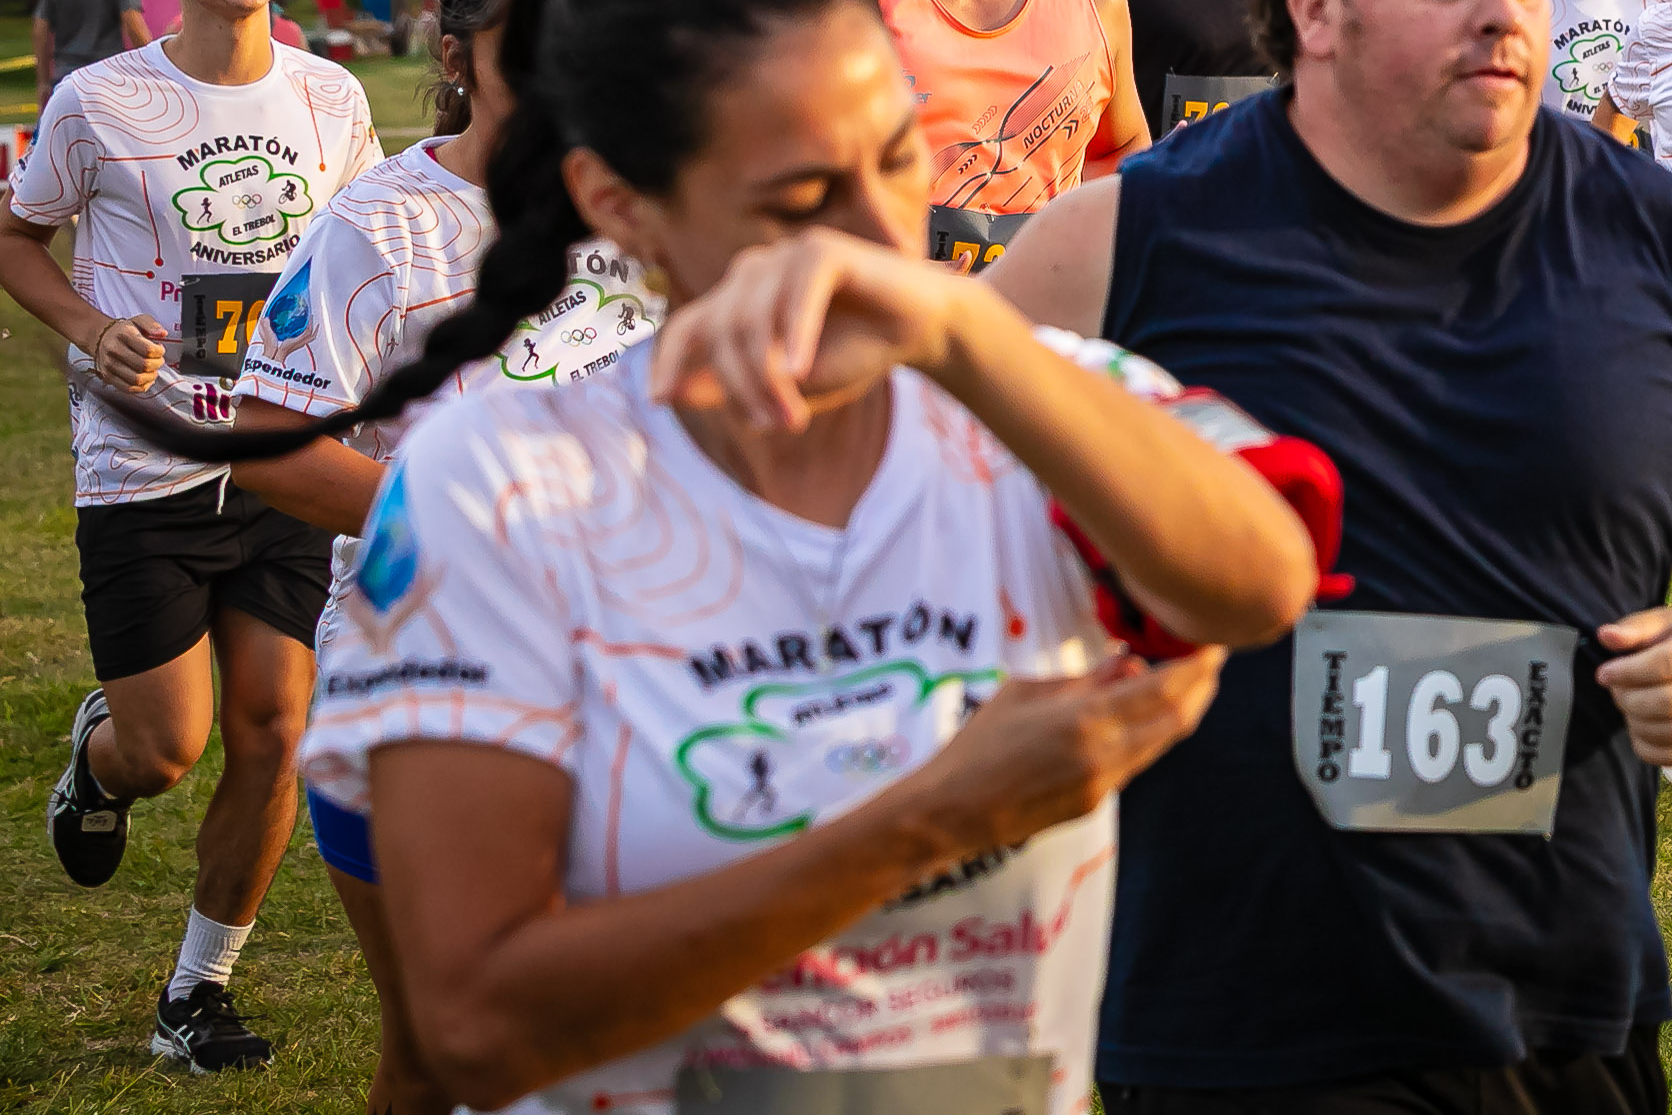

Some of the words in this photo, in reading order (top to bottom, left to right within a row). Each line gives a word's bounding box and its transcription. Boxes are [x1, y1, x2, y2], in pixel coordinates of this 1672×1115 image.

[1185, 101, 1230, 122] 7
[176, 135, 298, 171] MARATÓN
[219, 165, 259, 188] ATLETAS
[232, 226, 242, 236] EL
[243, 214, 276, 232] TREBOL
[189, 234, 300, 265] ANIVERSARIO
[570, 369, 584, 382] EL
[1317, 651, 1347, 783] TIEMPO
[1348, 665, 1522, 786] 163
[1514, 660, 1548, 791] EXACTO
